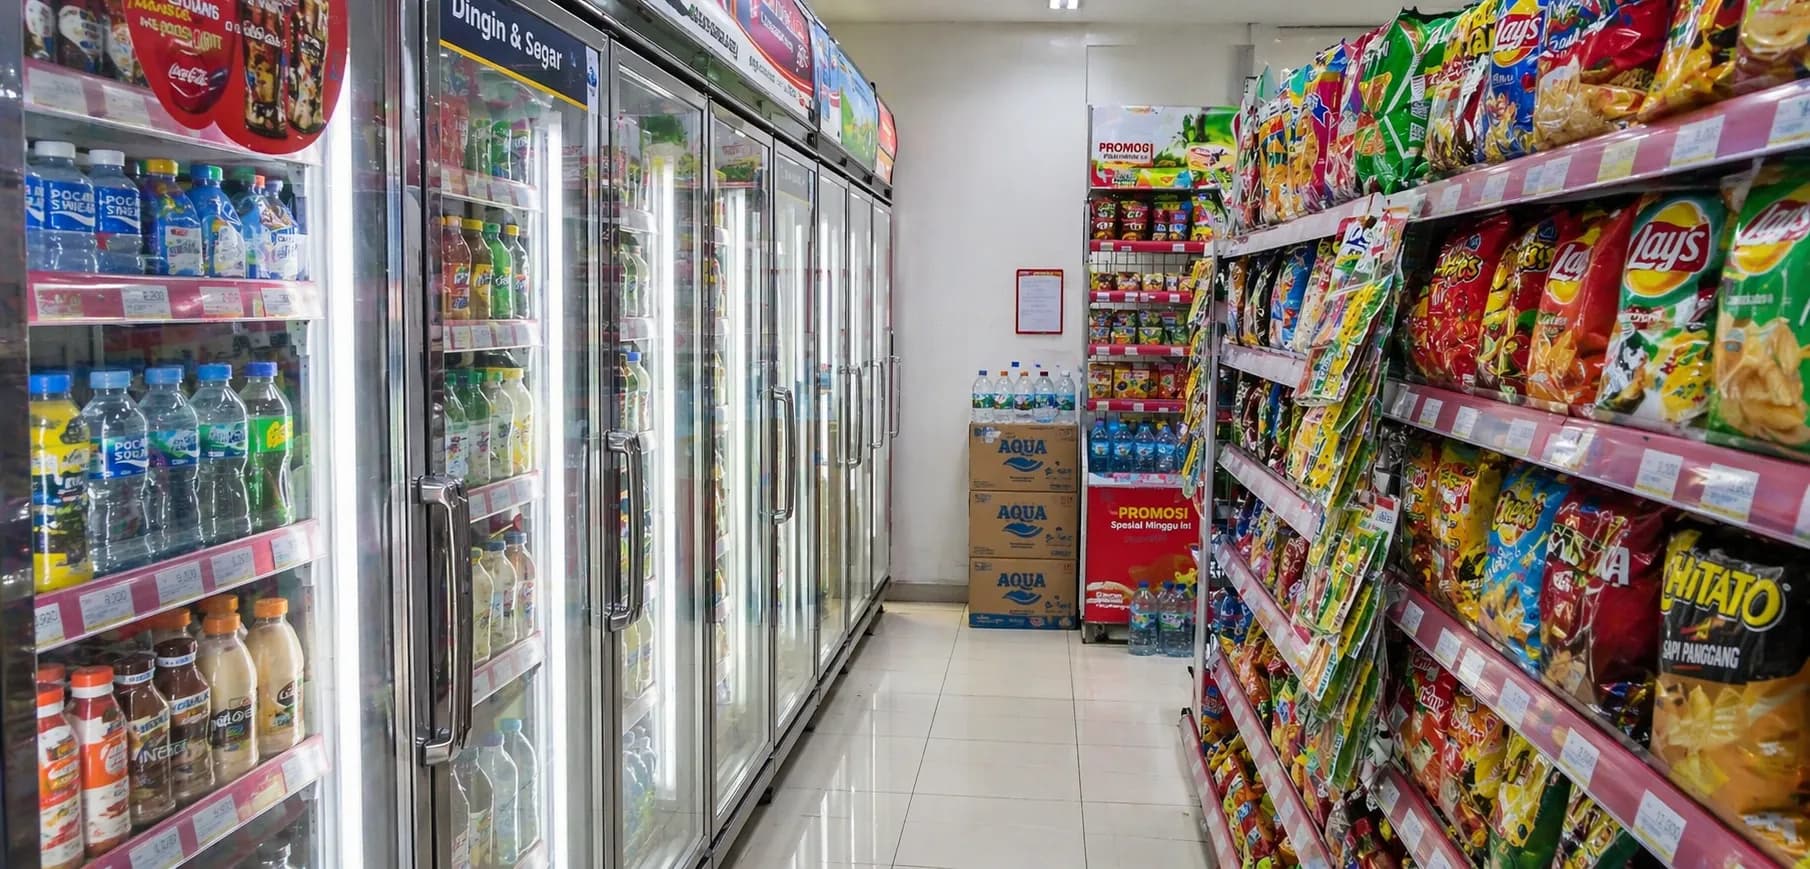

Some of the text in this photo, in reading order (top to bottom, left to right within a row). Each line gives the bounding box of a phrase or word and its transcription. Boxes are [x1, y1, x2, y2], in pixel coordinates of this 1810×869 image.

[452, 0, 563, 71] Dingin & Segar
[1626, 224, 1706, 272] Lay's
[997, 438, 1048, 457] AQUA
[996, 504, 1048, 523] AQUA
[1118, 506, 1189, 519] PROMOSI
[1145, 521, 1179, 532] Minggu
[996, 572, 1047, 591] AQUA
[1663, 639, 1741, 670] SAPI PANGGANG
